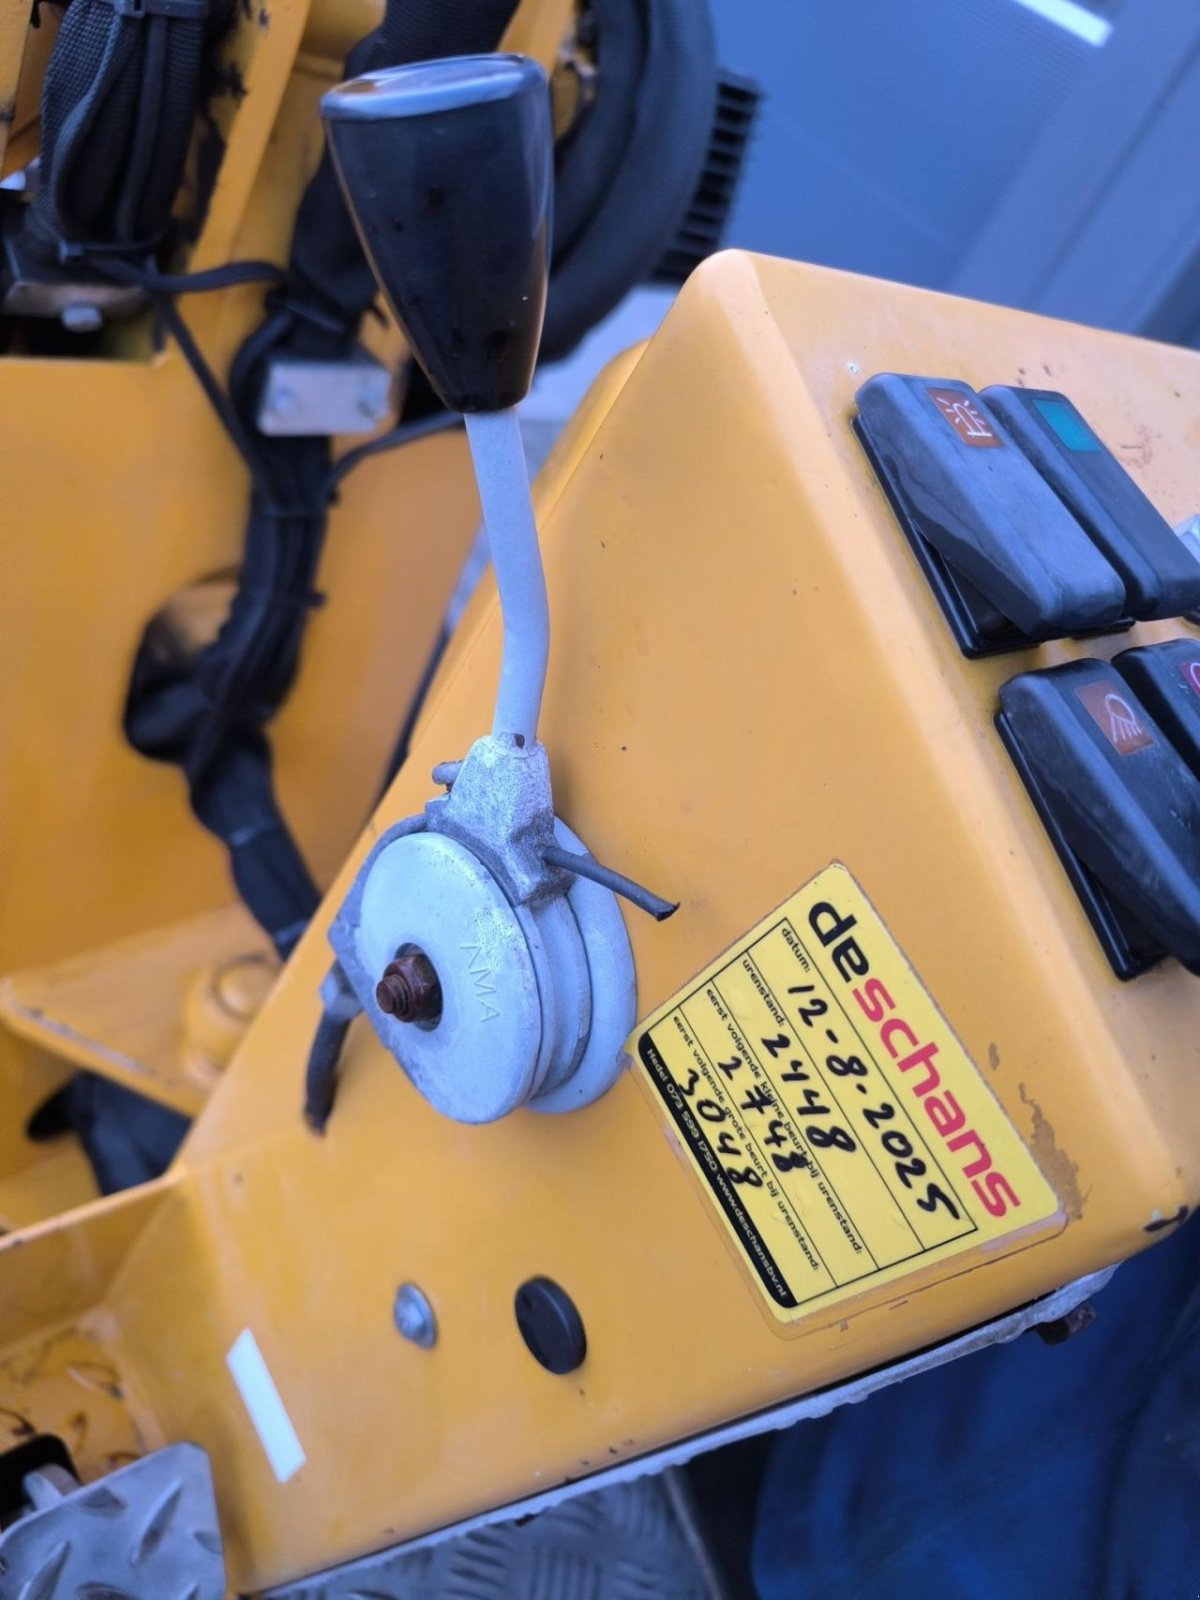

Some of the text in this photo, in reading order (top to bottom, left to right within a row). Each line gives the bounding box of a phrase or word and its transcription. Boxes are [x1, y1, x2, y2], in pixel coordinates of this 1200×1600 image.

[742, 959, 786, 1027] urenstand:
[781, 928, 811, 973] datum:
[718, 1055, 808, 1173] 2748
[761, 1033, 857, 1153] 2448
[808, 901, 1021, 1218] deschans
[647, 1048, 787, 1296] Hedel 073 599 1750 www.deschansbv.nl
[673, 1015, 820, 1271] eerst volgende grote beurt bij urenstand:
[678, 1068, 763, 1188] 3048
[706, 988, 863, 1255] eerst volgende kleine beurt bij urenstand:
